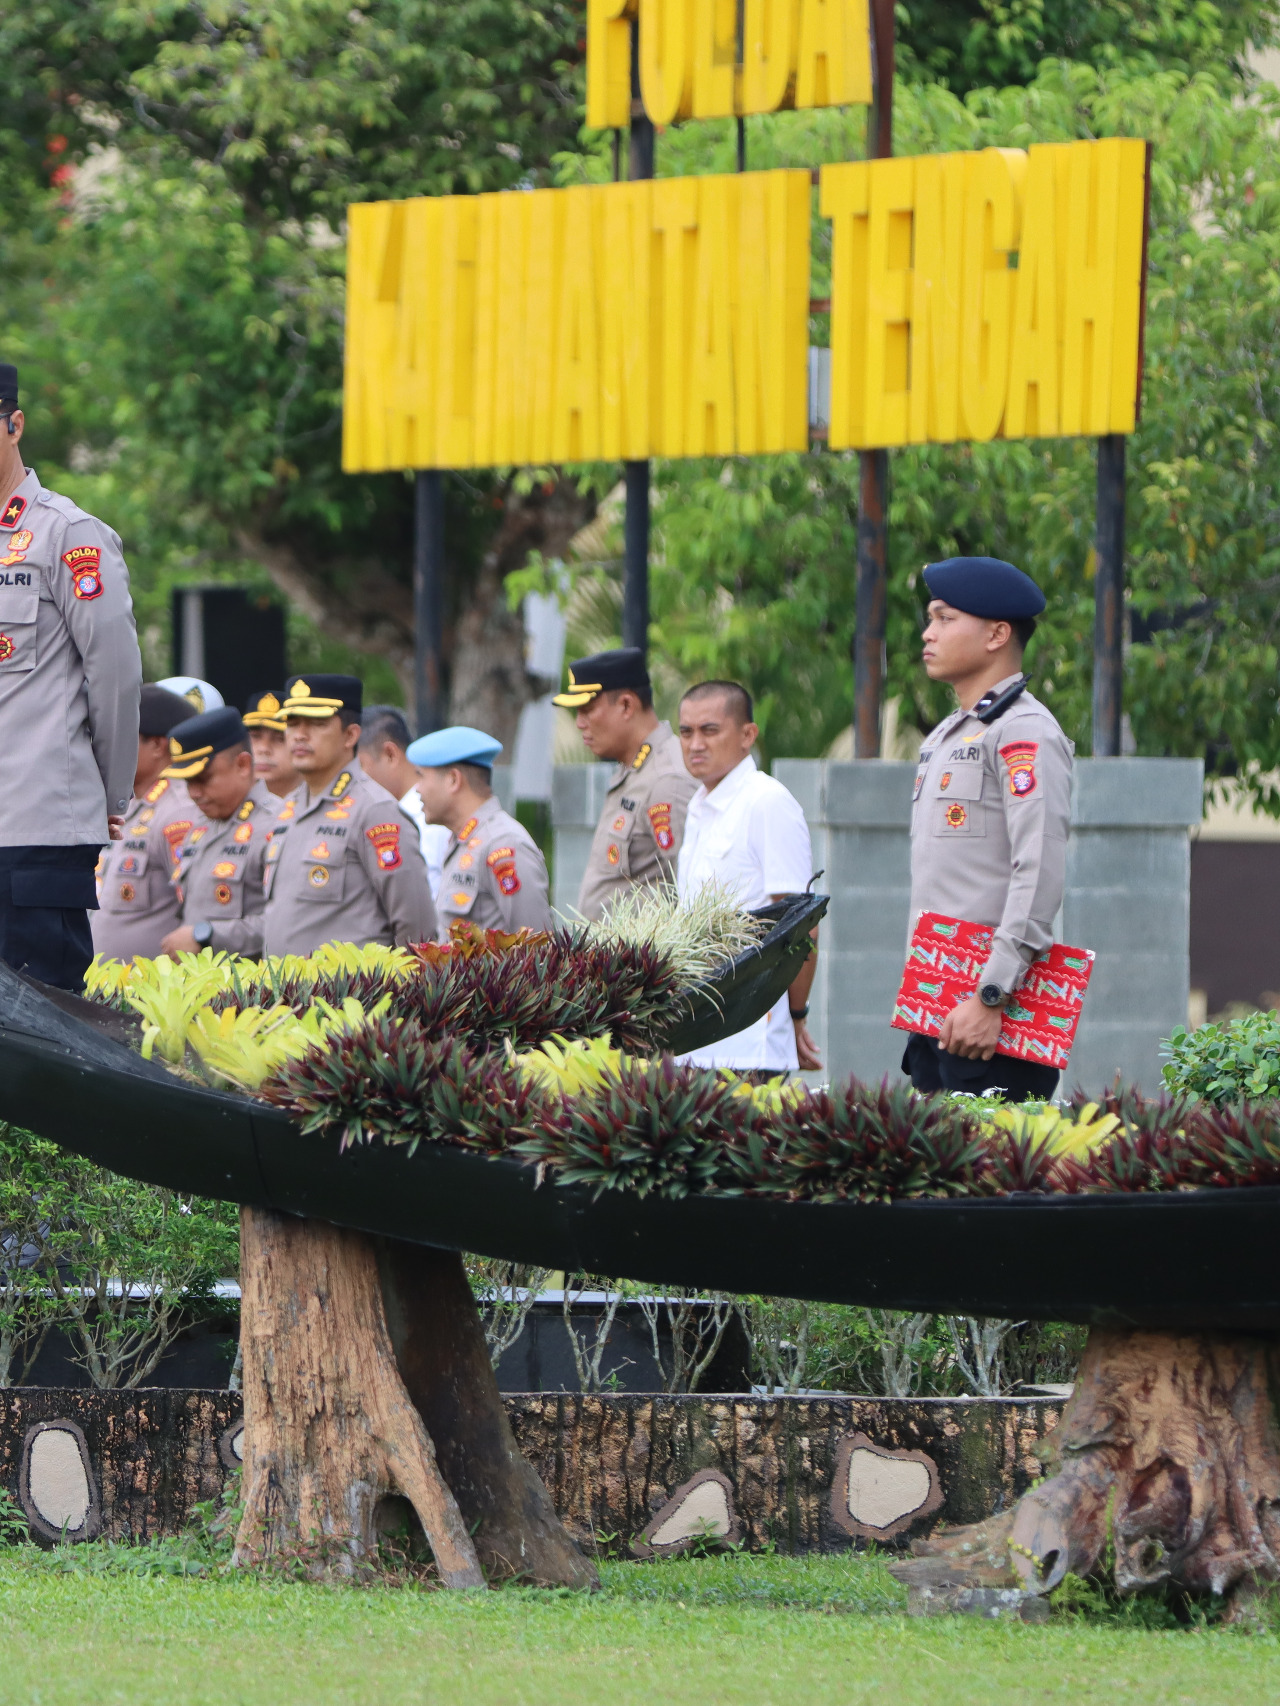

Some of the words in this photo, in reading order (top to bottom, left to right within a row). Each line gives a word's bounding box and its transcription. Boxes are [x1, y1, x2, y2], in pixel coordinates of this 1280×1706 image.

[342, 168, 811, 474] KALIMANTAN
[819, 137, 1148, 450] TENGAH
[65, 547, 98, 563] POLDA
[948, 746, 980, 762] POLRI
[369, 824, 398, 838] POLDA
